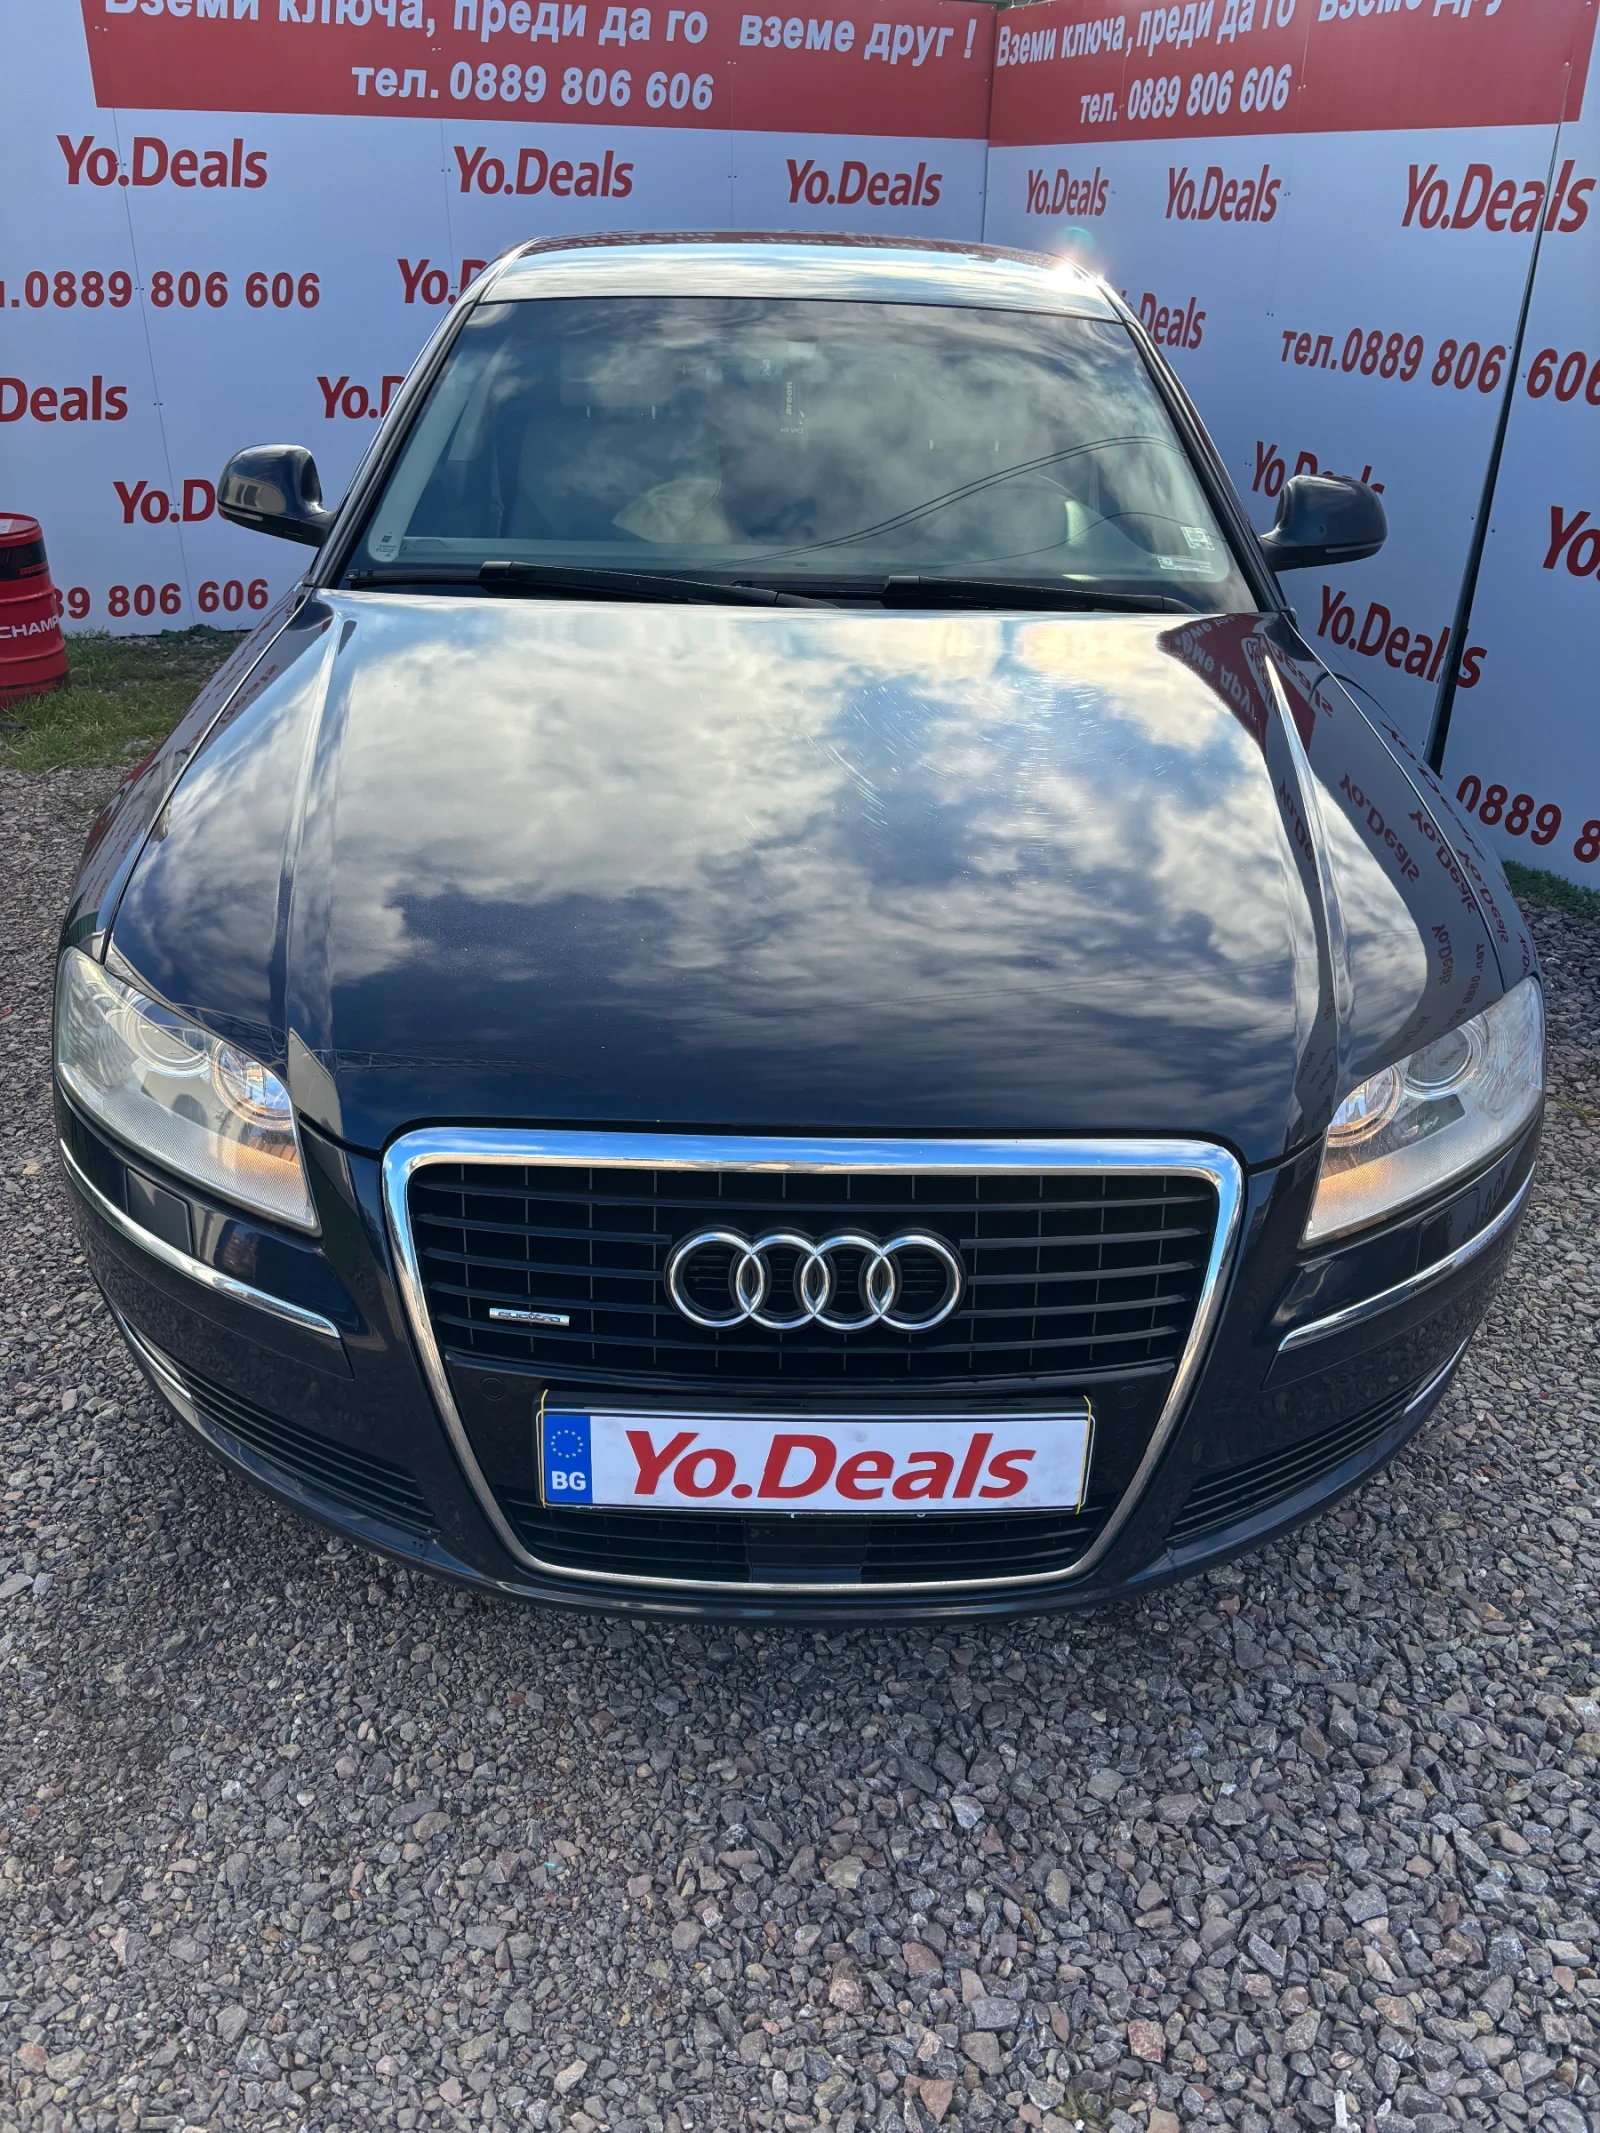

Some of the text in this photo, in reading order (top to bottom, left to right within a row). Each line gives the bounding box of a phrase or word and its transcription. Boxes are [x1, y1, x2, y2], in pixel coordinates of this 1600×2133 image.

[278, 0, 436, 38] ключа,
[453, 0, 588, 43] преди
[598, 7, 651, 47] да
[666, 10, 709, 44] го
[739, 14, 856, 53] вземе
[863, 23, 955, 67] друг
[996, 26, 1056, 67] Вземи
[1136, 0, 1215, 57] преди
[1216, 0, 1255, 45] да
[351, 61, 714, 110] тел. 0889 806 606
[1079, 63, 1293, 124] тел. 0889 806 606
[56, 134, 268, 190] Yo.Deals
[453, 145, 634, 198] Yo.Deals
[786, 158, 943, 207] Yo.Deals
[1025, 166, 1110, 217] Yo.Deals
[1165, 163, 1282, 223] Yo.Deals
[1401, 159, 1597, 233] Yo.Deals
[0, 270, 321, 309] .0889 806 606
[1280, 327, 1424, 383] тел.0889
[1431, 339, 1506, 394] 806
[113, 479, 228, 524] Yo.D
[1542, 505, 1600, 582] Yo
[107, 582, 182, 618] 806
[198, 578, 269, 613] 606
[1317, 584, 1488, 689] Yo.Deals
[1456, 774, 1562, 846] 0889
[551, 1429, 1037, 1501] BG Yo.Deals
